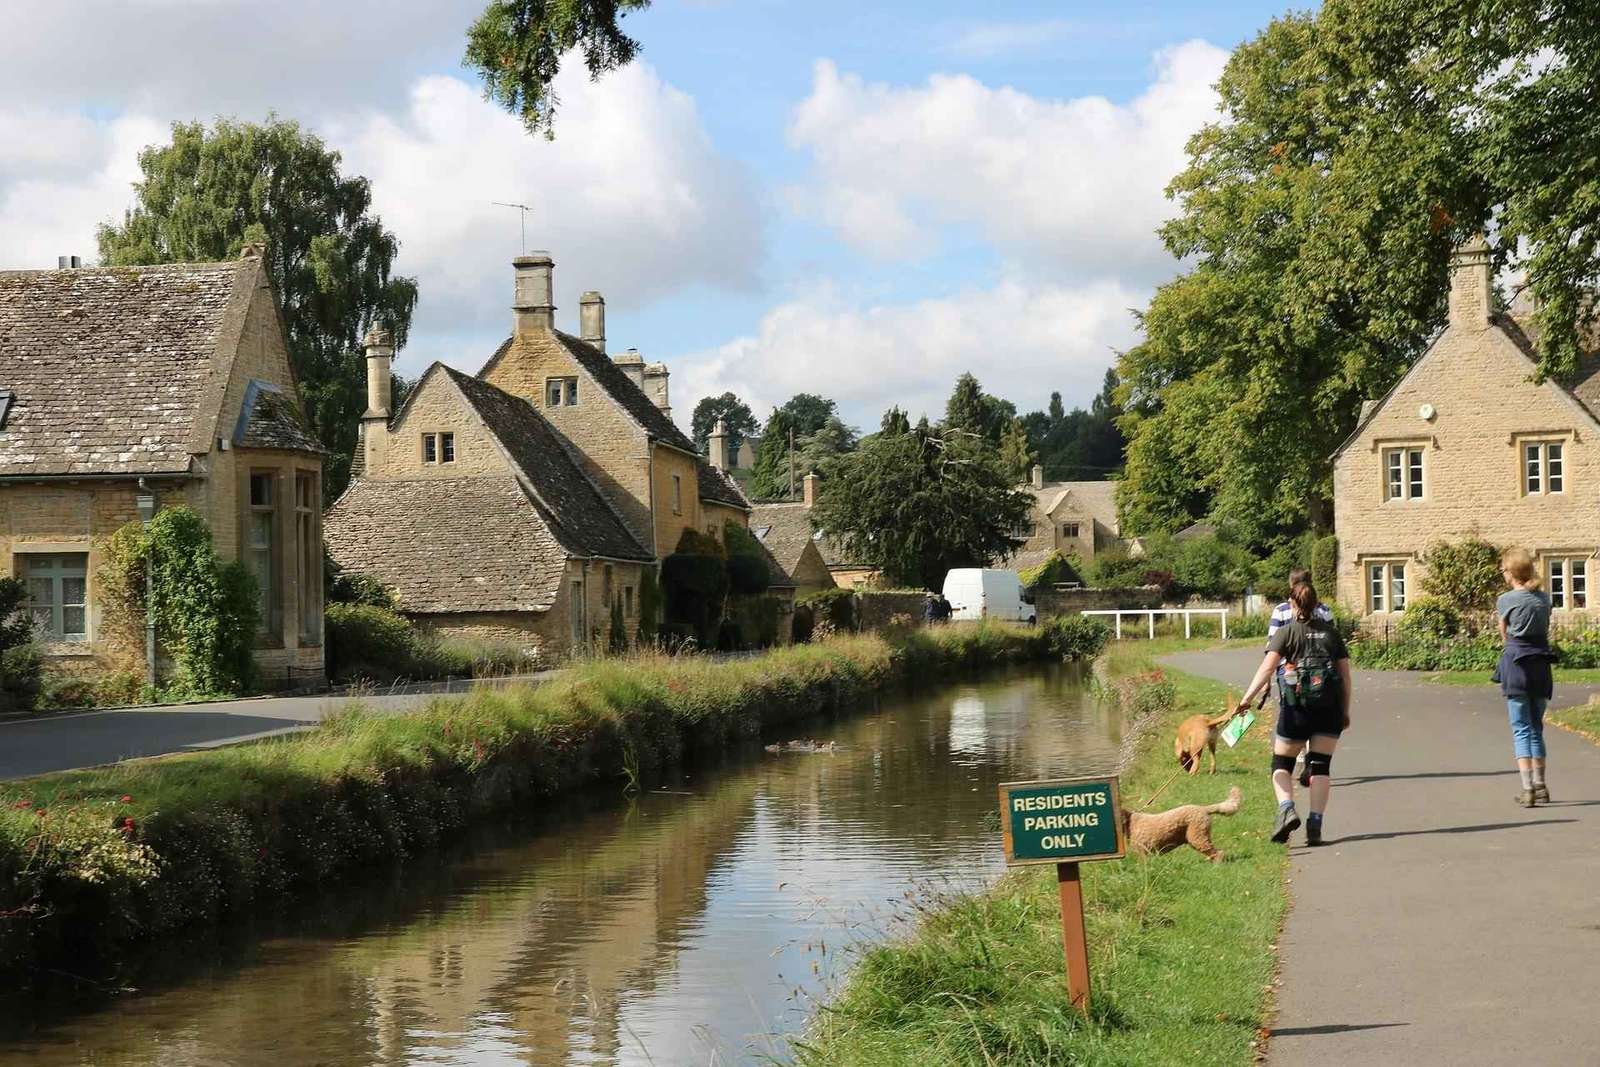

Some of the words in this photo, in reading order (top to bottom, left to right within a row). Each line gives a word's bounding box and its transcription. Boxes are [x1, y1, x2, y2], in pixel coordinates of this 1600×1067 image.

[1014, 792, 1106, 811] RESIDENTS
[1024, 813, 1099, 830] PARKING
[1041, 834, 1085, 849] ONLY
